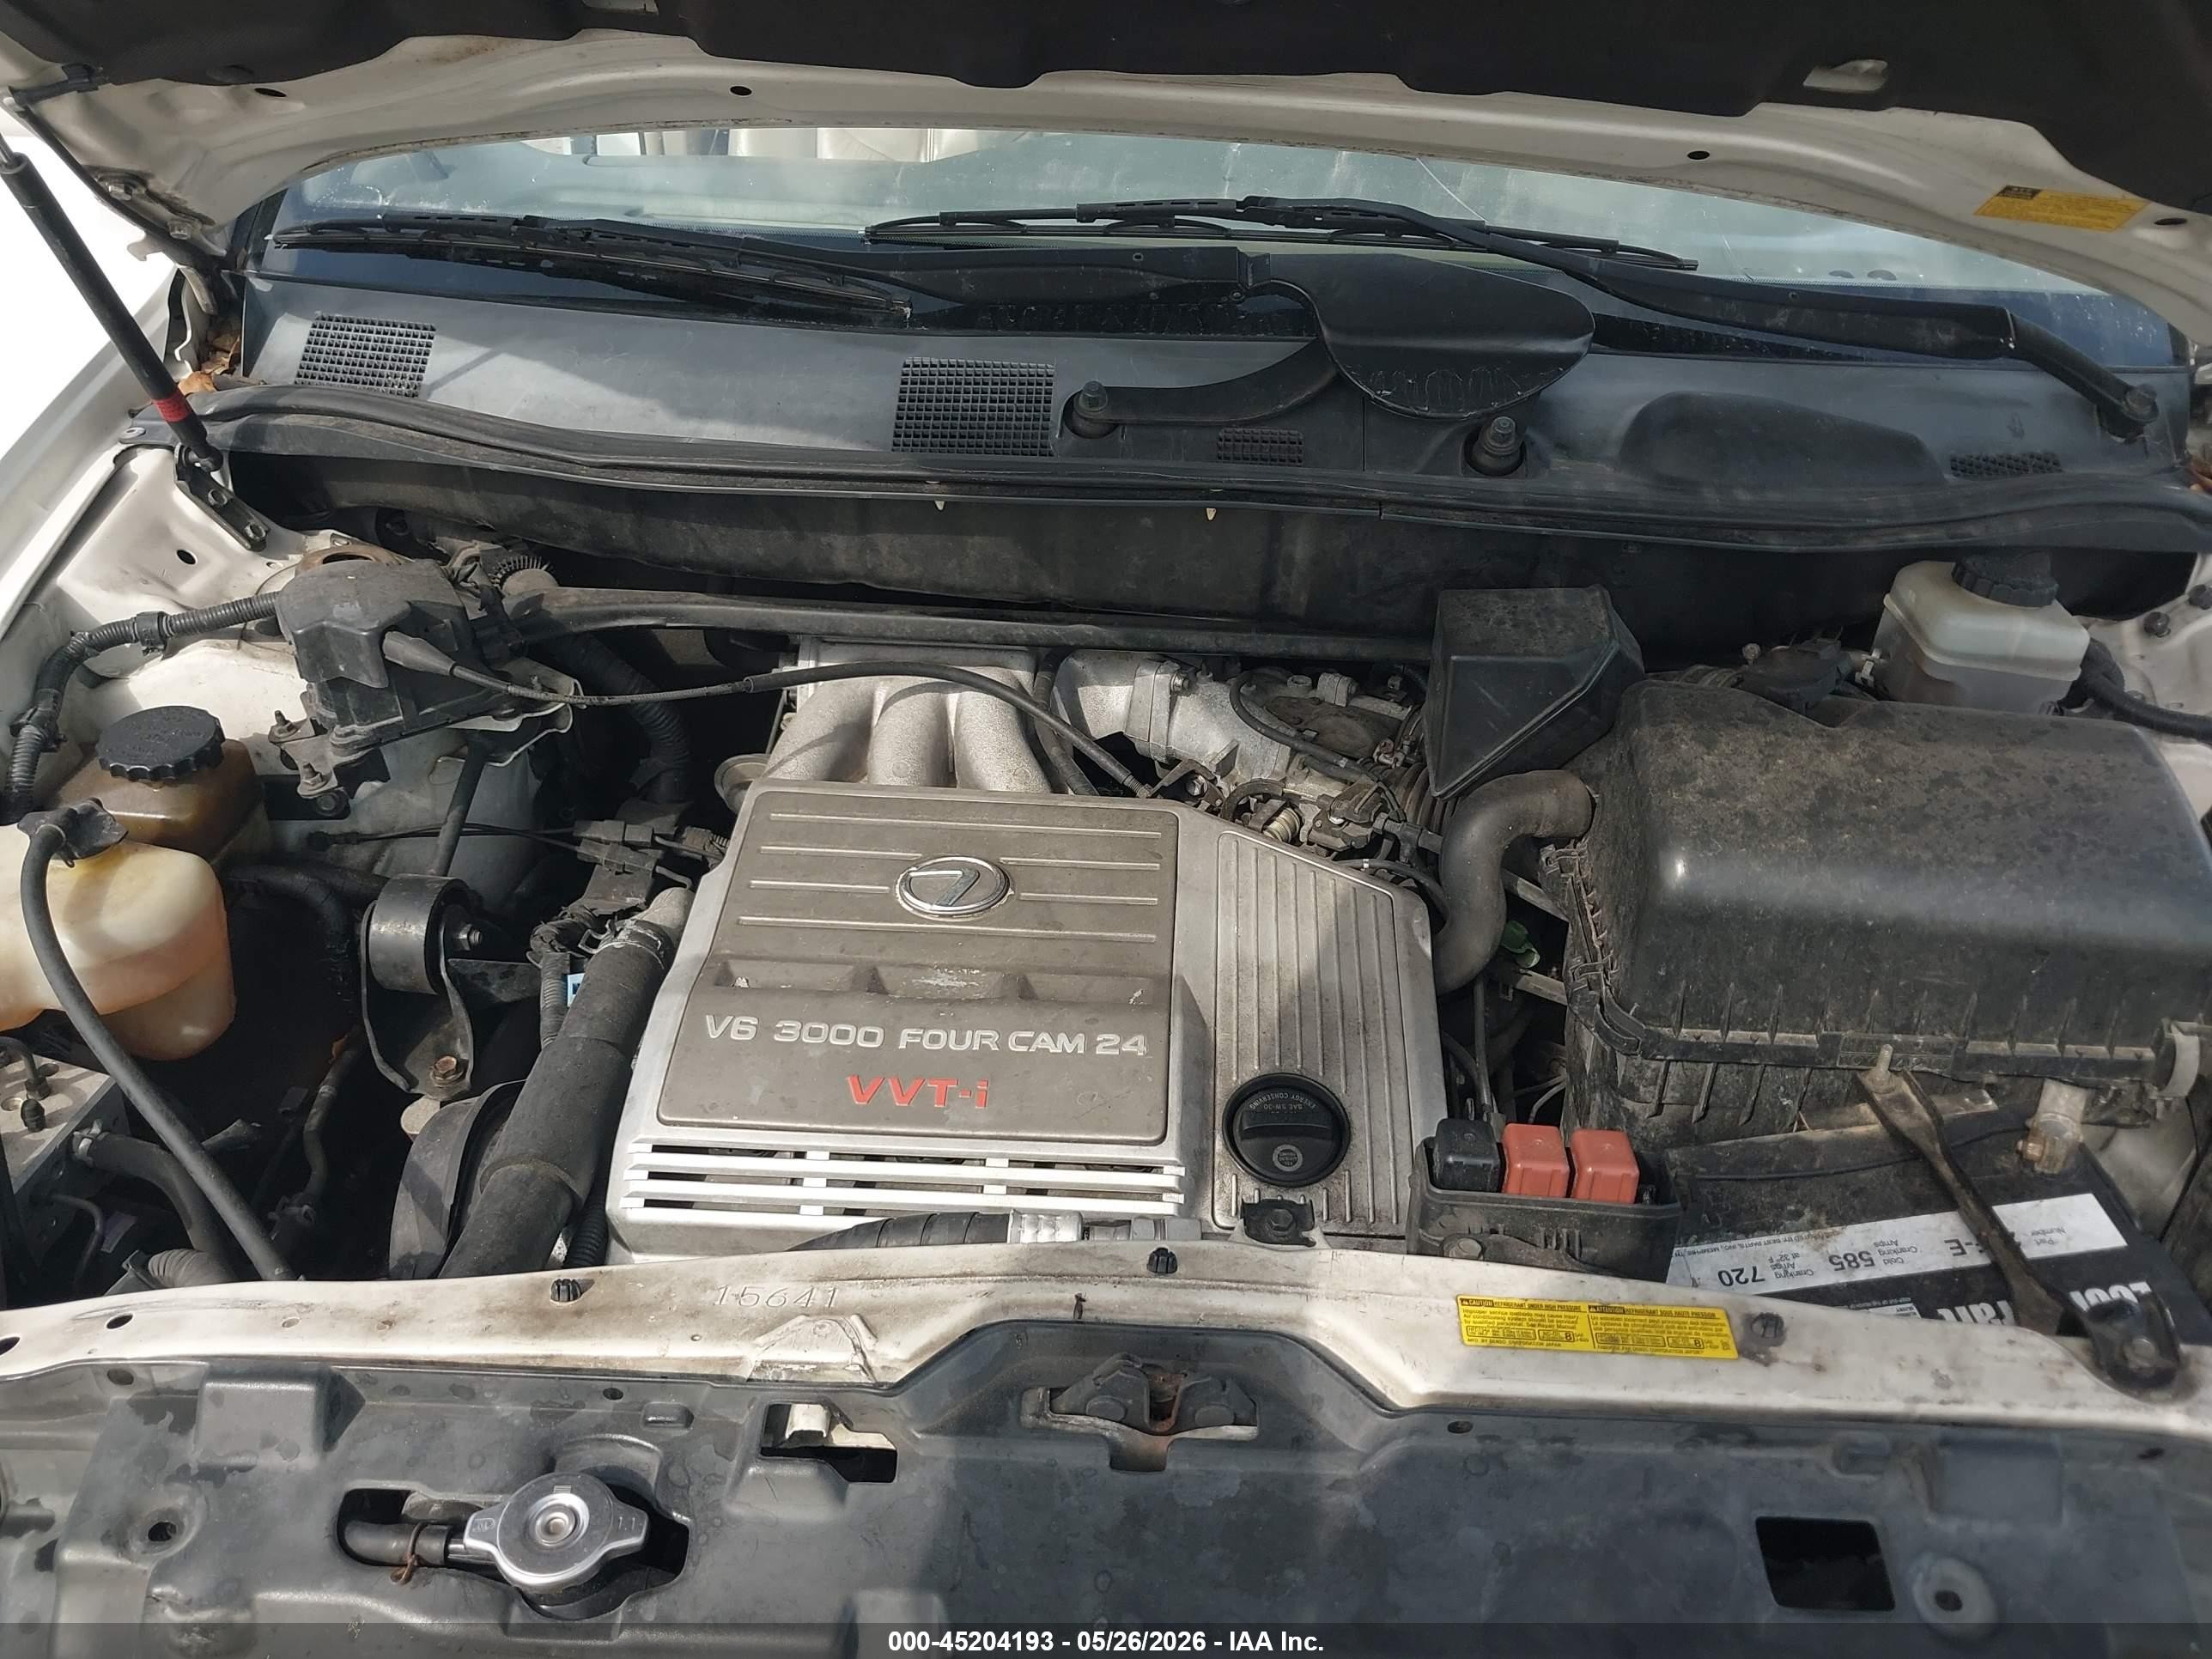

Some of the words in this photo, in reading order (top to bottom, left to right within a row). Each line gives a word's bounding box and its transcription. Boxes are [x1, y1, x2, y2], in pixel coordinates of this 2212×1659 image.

[705, 1014, 758, 1041] V6
[773, 1019, 884, 1048] 3000
[898, 1029, 1000, 1051] FOUR
[1008, 1030, 1085, 1054] CAM
[1095, 1033, 1147, 1056] 24
[847, 1074, 990, 1109] VVT-i
[1873, 1239, 1899, 1248] Amps
[1877, 1246, 1917, 1256] Cranking
[1828, 1250, 1875, 1272] 585
[1883, 1257, 1904, 1266] Cold
[1718, 1265, 1765, 1287] 720
[1775, 1268, 1814, 1279] Cranking
[714, 1285, 839, 1309] 15641
[1565, 1333, 1572, 1341] 8
[1693, 1339, 1701, 1348] 8
